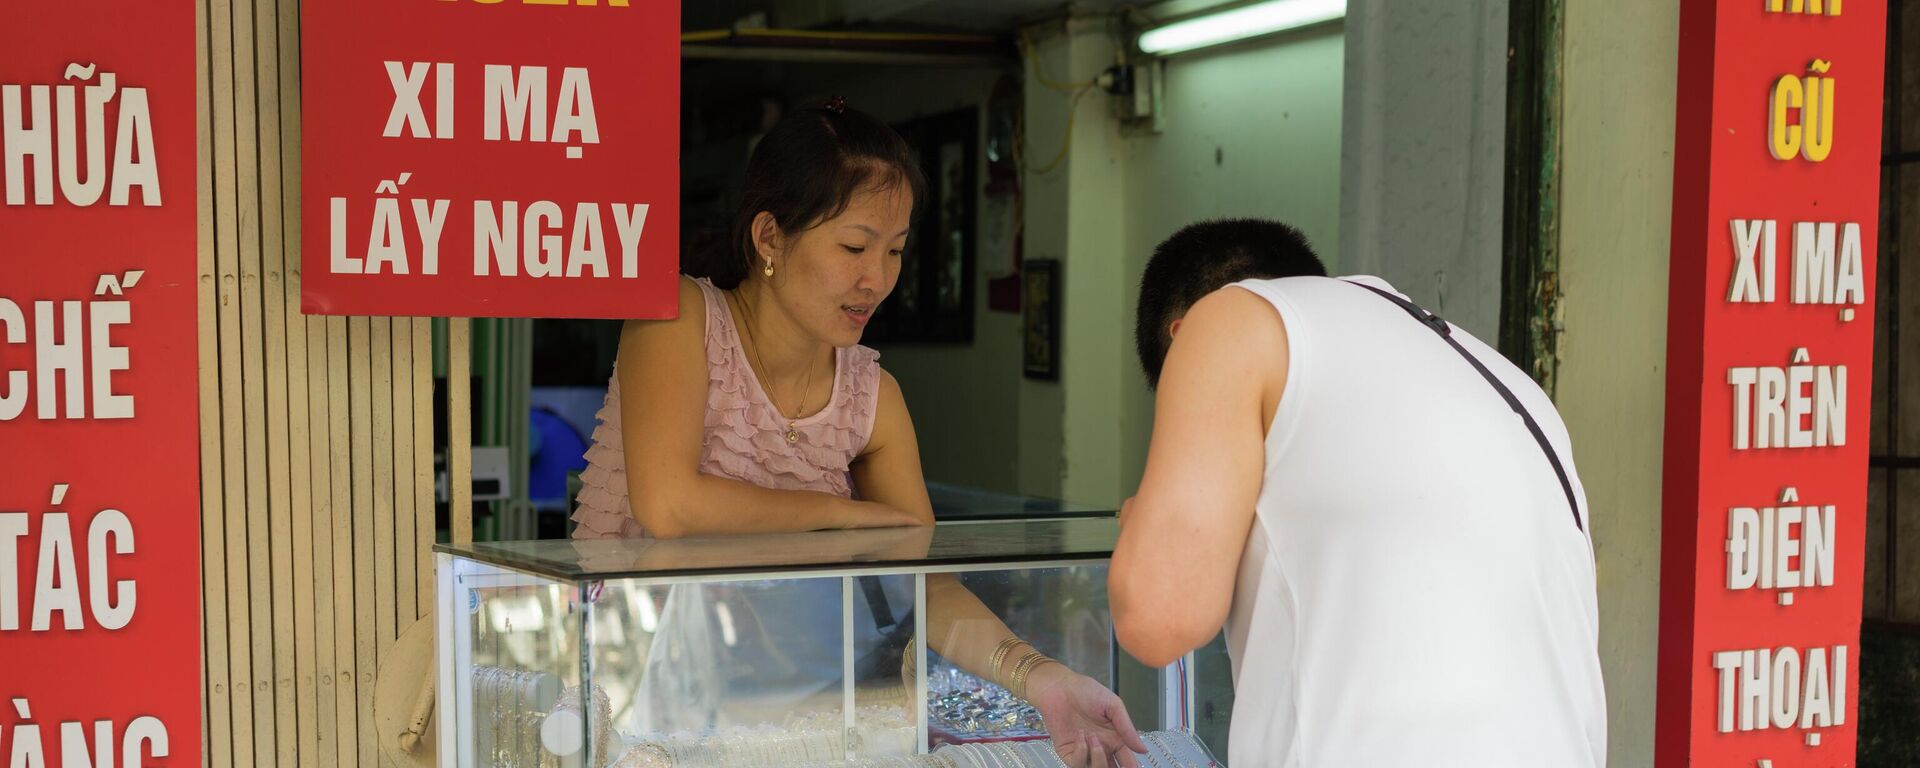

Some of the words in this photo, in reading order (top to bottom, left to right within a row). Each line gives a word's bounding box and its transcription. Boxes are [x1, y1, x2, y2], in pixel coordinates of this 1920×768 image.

[2, 62, 162, 207] HỮA
[382, 60, 455, 138] XI
[483, 64, 600, 159] MẠ
[1767, 58, 1835, 162] CŨ
[330, 172, 451, 275] LẤY
[473, 200, 650, 279] NGAY
[1726, 219, 1777, 303] XI
[1790, 221, 1865, 322] MẠ
[1727, 346, 1847, 450] TRÊN
[0, 484, 137, 631] TÁC
[1725, 486, 1836, 606] ĐIỆN
[1712, 645, 1848, 746] THOẠI
